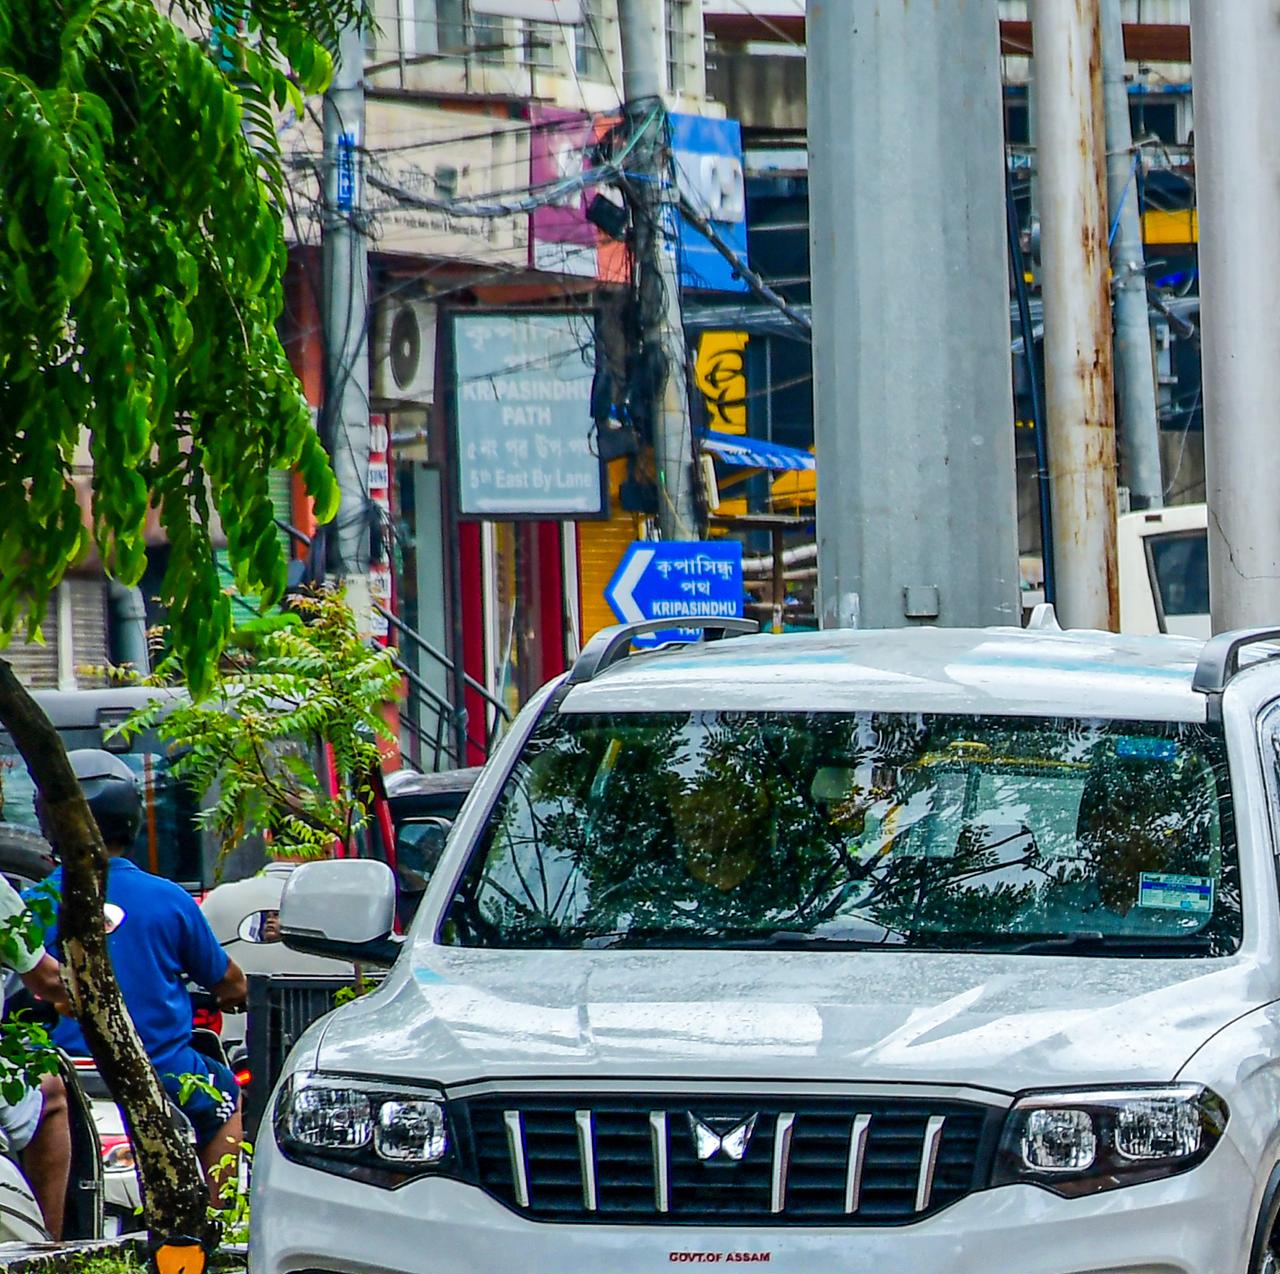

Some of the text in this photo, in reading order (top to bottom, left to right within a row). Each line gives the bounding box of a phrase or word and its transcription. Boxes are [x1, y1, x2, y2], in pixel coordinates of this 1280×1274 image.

[502, 406, 551, 425] PATH
[470, 469, 592, 492] 5th East By Lane
[652, 601, 737, 616] KRIPASINDHU
[725, 1252, 771, 1262] ASSAM
